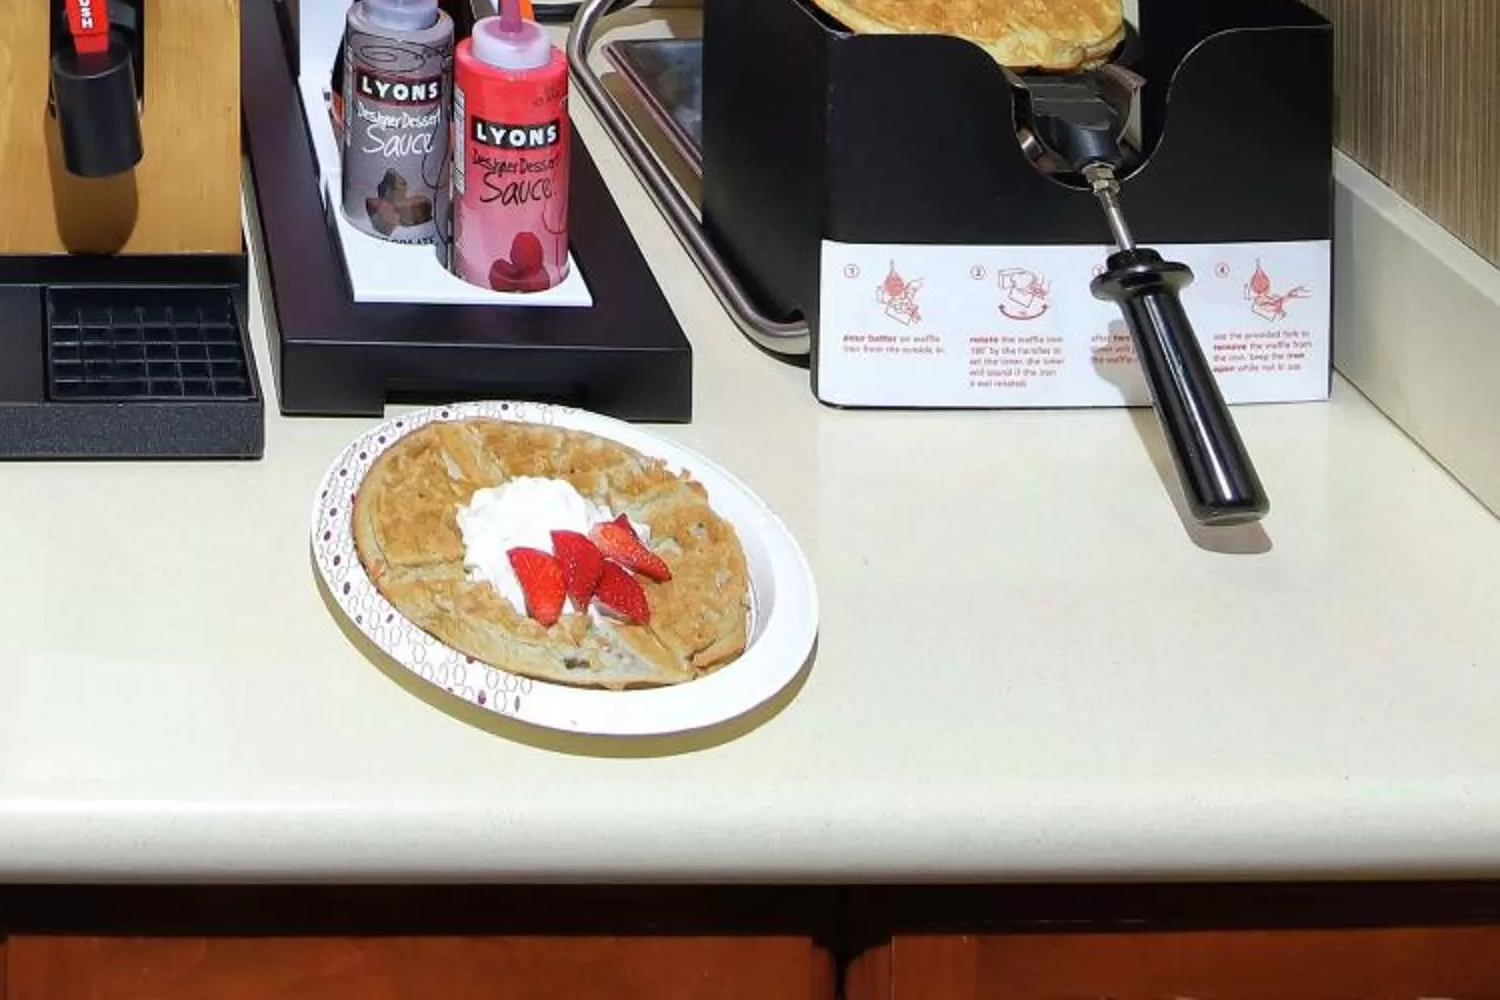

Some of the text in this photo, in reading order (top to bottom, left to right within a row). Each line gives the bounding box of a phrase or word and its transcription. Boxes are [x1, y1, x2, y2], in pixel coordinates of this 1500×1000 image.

[362, 74, 439, 101] LYONS
[362, 123, 434, 158] Sauce
[476, 122, 558, 147] LYONS
[479, 171, 553, 206] Sauce
